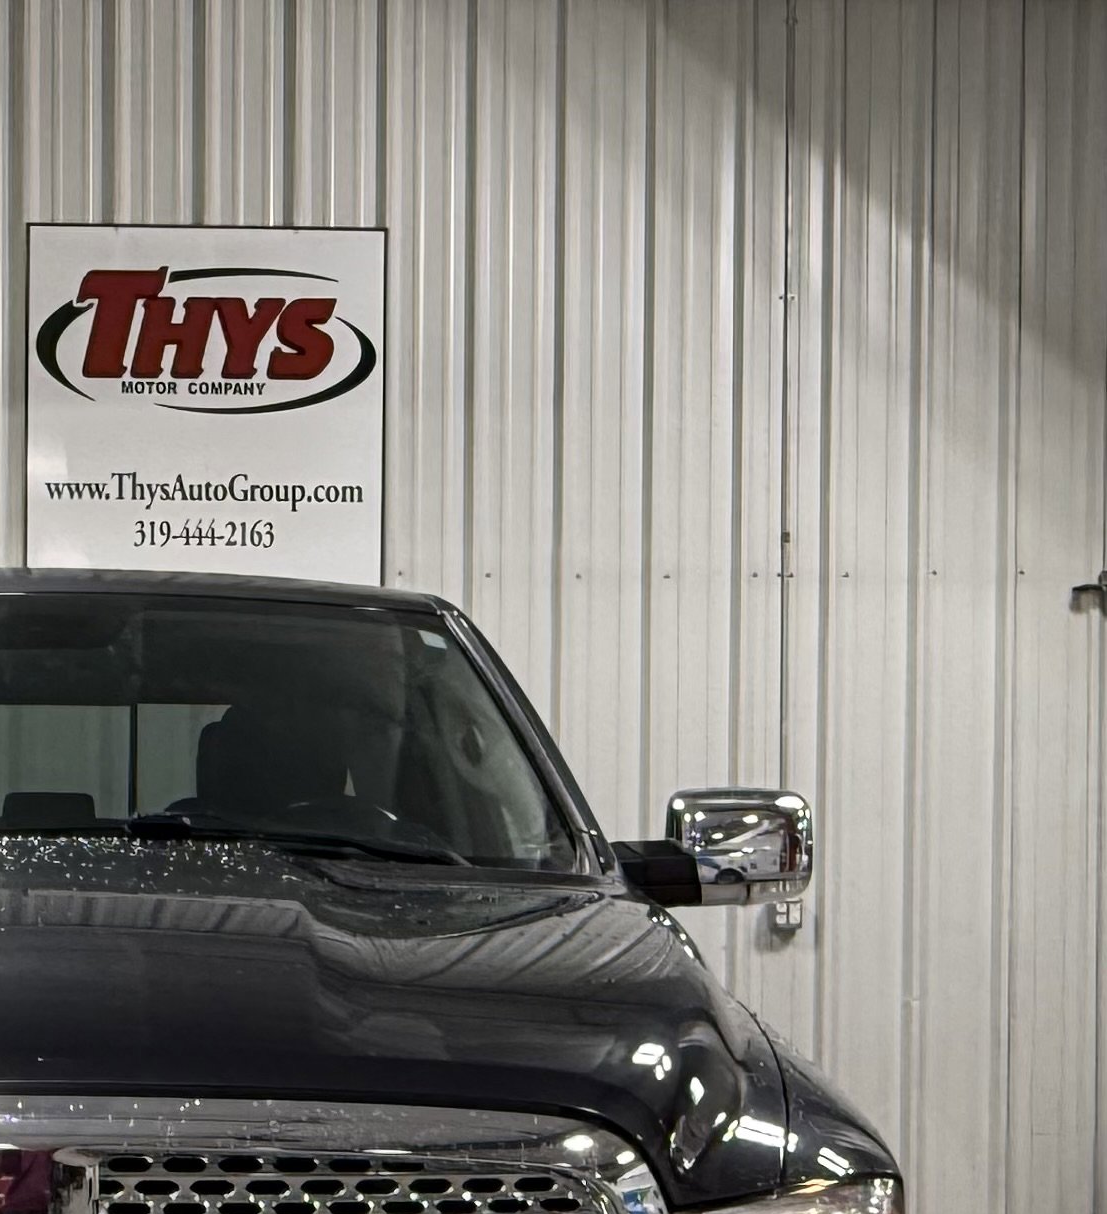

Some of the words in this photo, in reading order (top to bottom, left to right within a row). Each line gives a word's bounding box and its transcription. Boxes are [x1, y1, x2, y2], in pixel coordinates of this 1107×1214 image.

[76, 266, 337, 380] THYS
[121, 381, 178, 395] MOTOR
[188, 381, 266, 396] COMPANY
[45, 472, 364, 512] www.ThysAutoGroup.com
[133, 518, 276, 549] 319-444-2163
